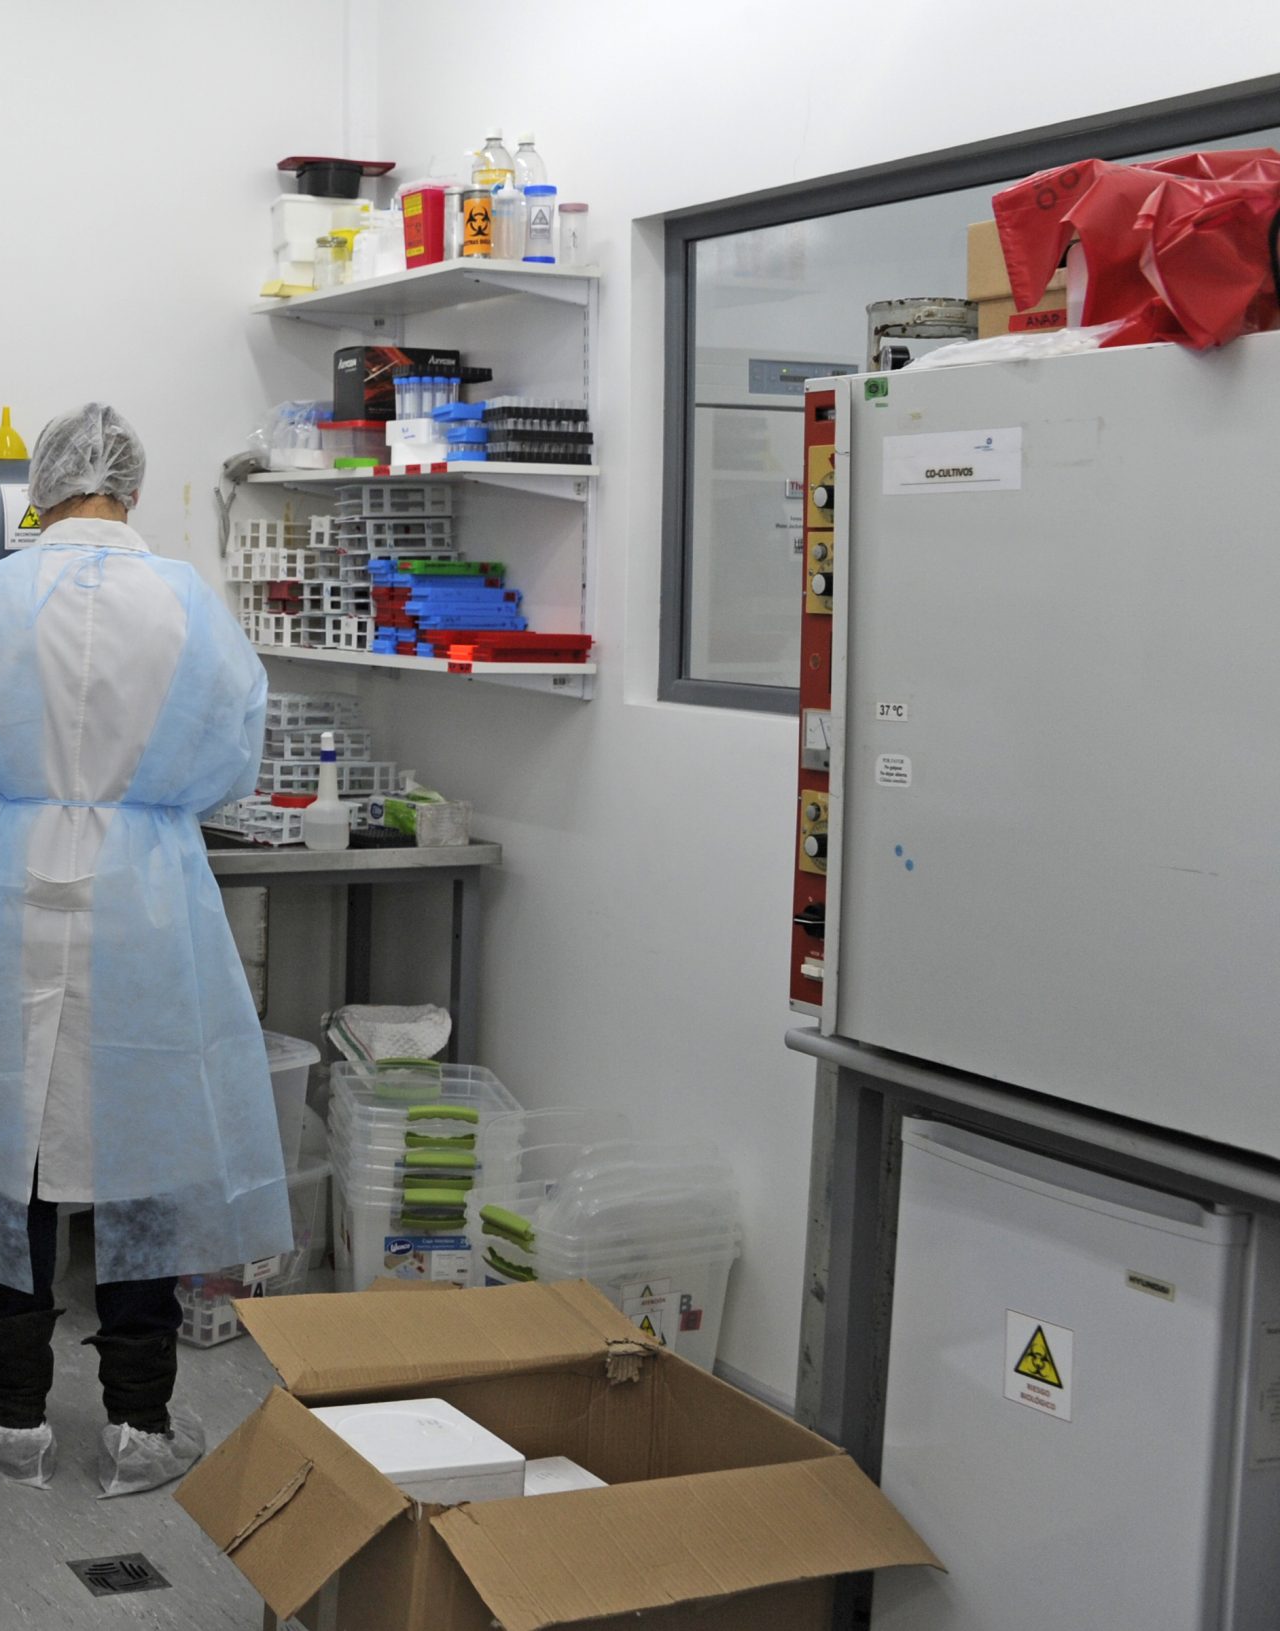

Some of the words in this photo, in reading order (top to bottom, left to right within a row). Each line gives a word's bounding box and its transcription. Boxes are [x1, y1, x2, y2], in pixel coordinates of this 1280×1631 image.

[925, 467, 973, 478] CO-CULTIVOS
[880, 704, 890, 716] 37
[1128, 1275, 1170, 1294] HYUNDAI
[680, 1294, 692, 1314] B
[1026, 1383, 1052, 1398] RIESGO
